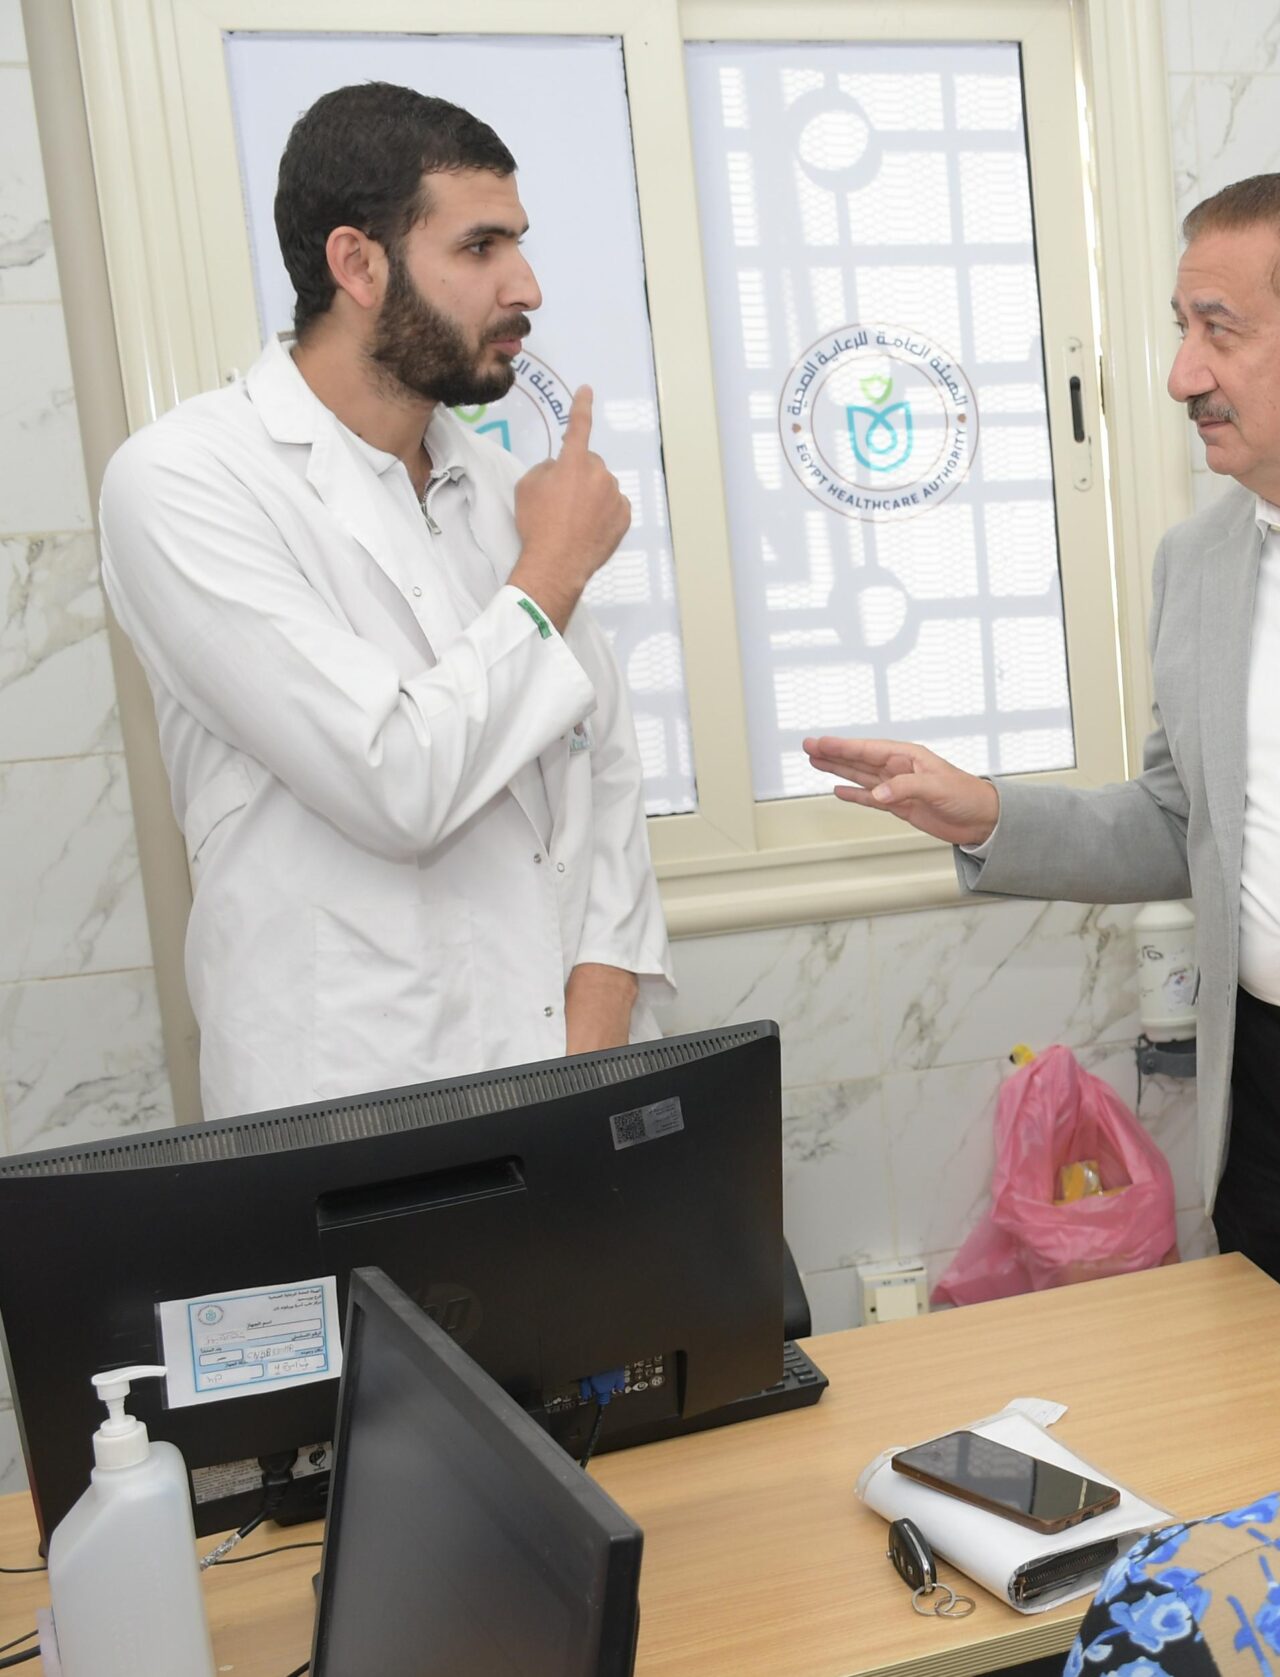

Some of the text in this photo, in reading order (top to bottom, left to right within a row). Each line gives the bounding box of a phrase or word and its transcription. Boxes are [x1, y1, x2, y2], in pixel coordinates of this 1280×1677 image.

[787, 331, 969, 416] الهيئة العامة للرعاية الصحية
[795, 428, 967, 511] EGYPT HEALTHCARE AUTHORITY
